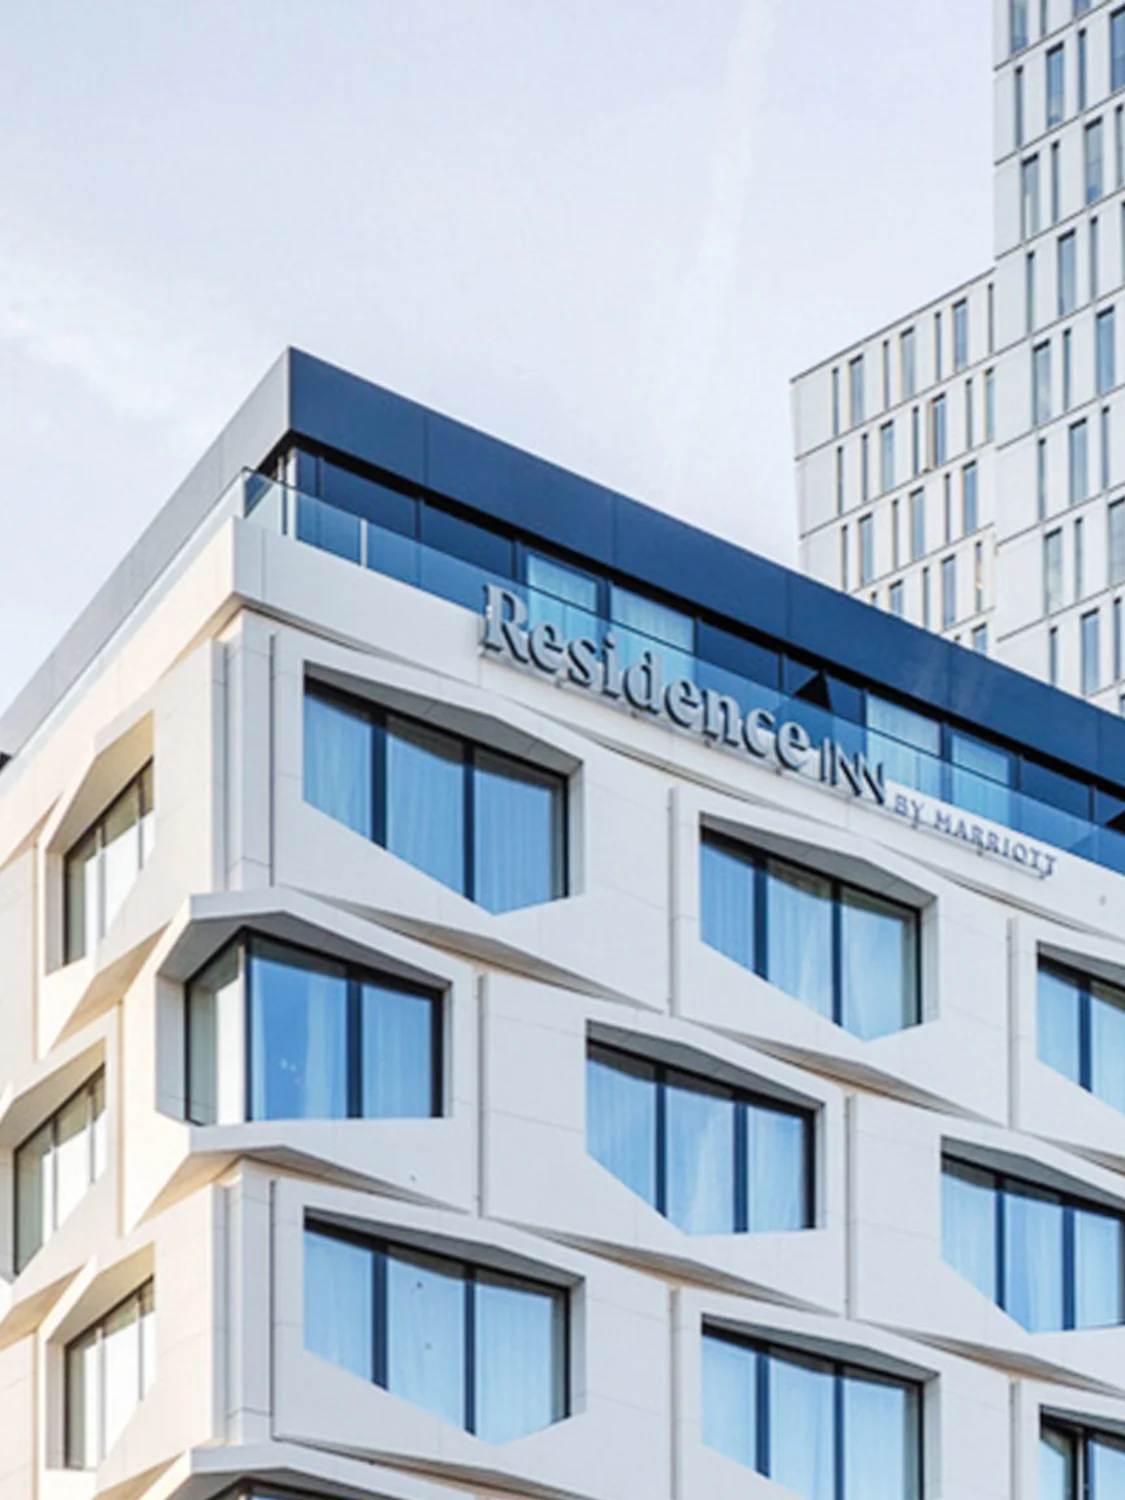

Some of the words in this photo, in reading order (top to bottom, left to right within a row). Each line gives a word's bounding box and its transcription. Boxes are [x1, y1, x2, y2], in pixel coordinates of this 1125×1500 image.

[481, 583, 811, 770] Residence
[894, 793, 925, 823] BY
[934, 810, 1058, 877] MARRIOTT
